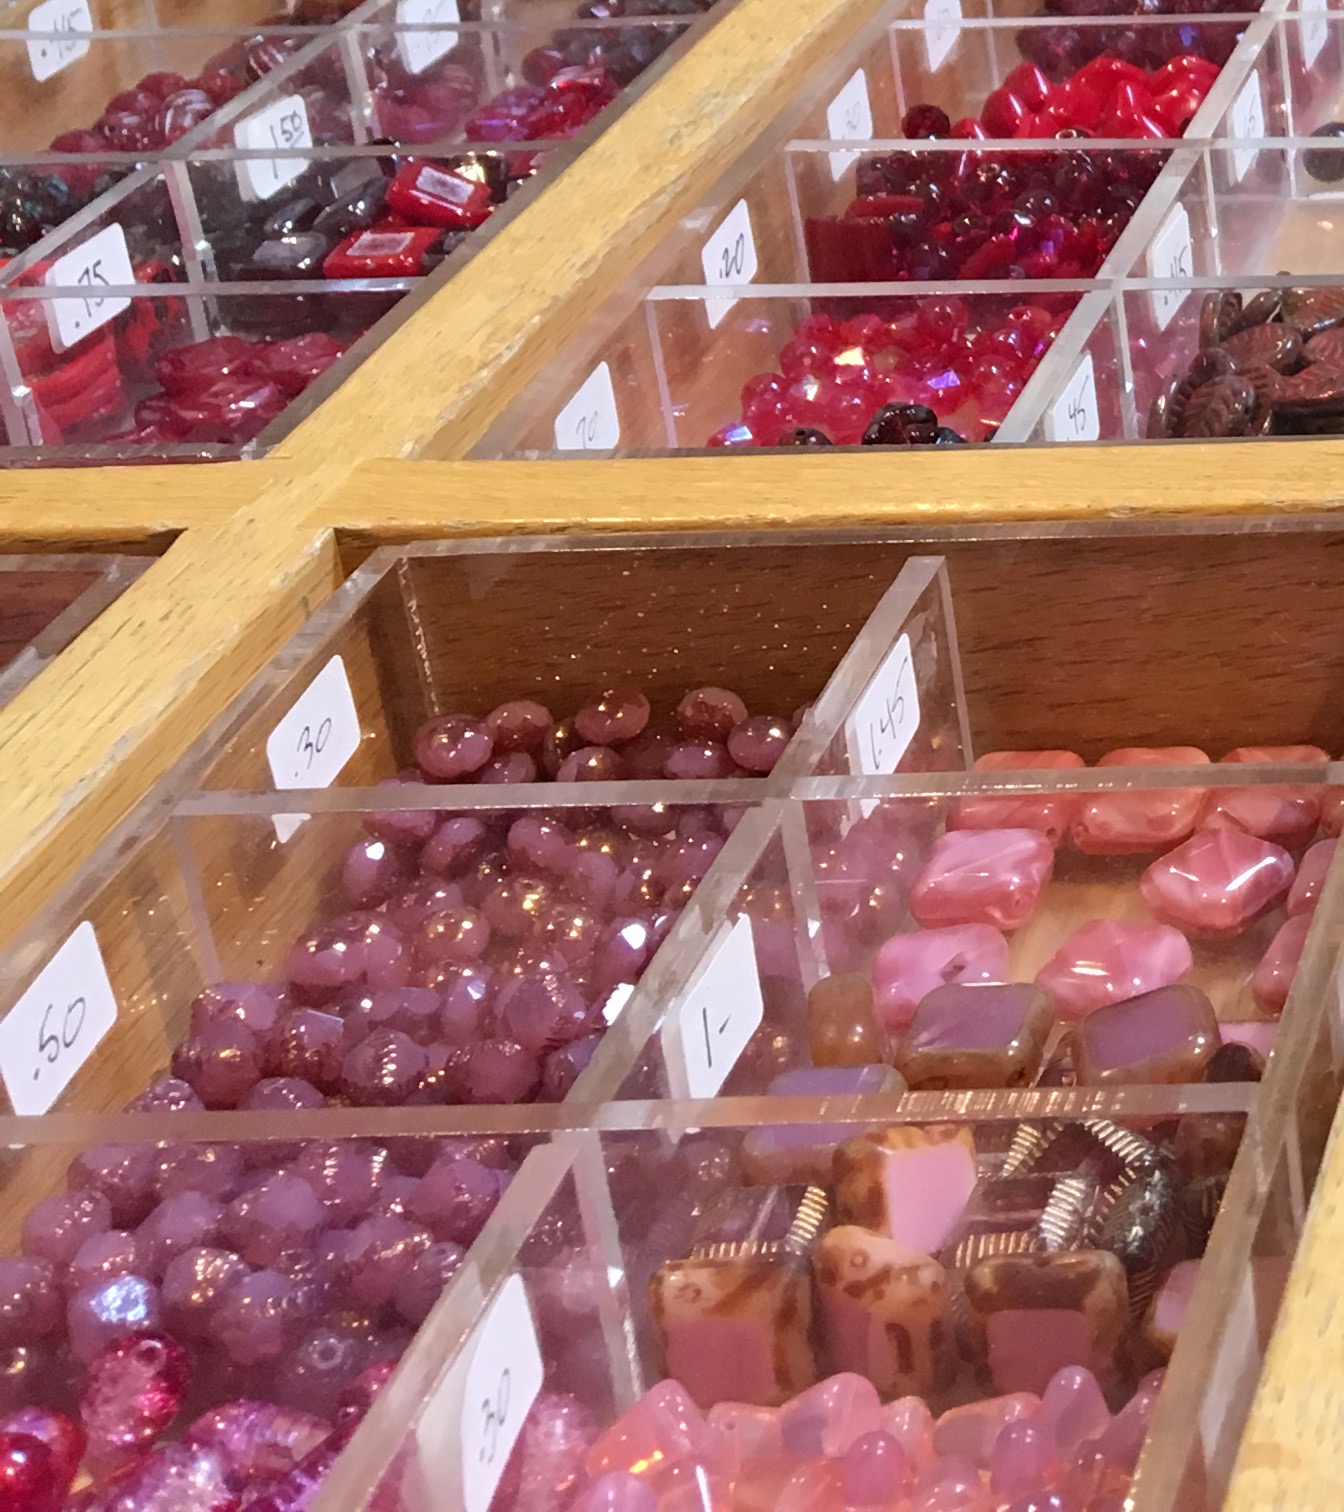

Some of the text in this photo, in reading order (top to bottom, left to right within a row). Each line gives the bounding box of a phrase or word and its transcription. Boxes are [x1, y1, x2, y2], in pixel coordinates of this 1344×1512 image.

[719, 233, 745, 279] .20
[293, 717, 332, 778] .30
[33, 996, 86, 1081] .50
